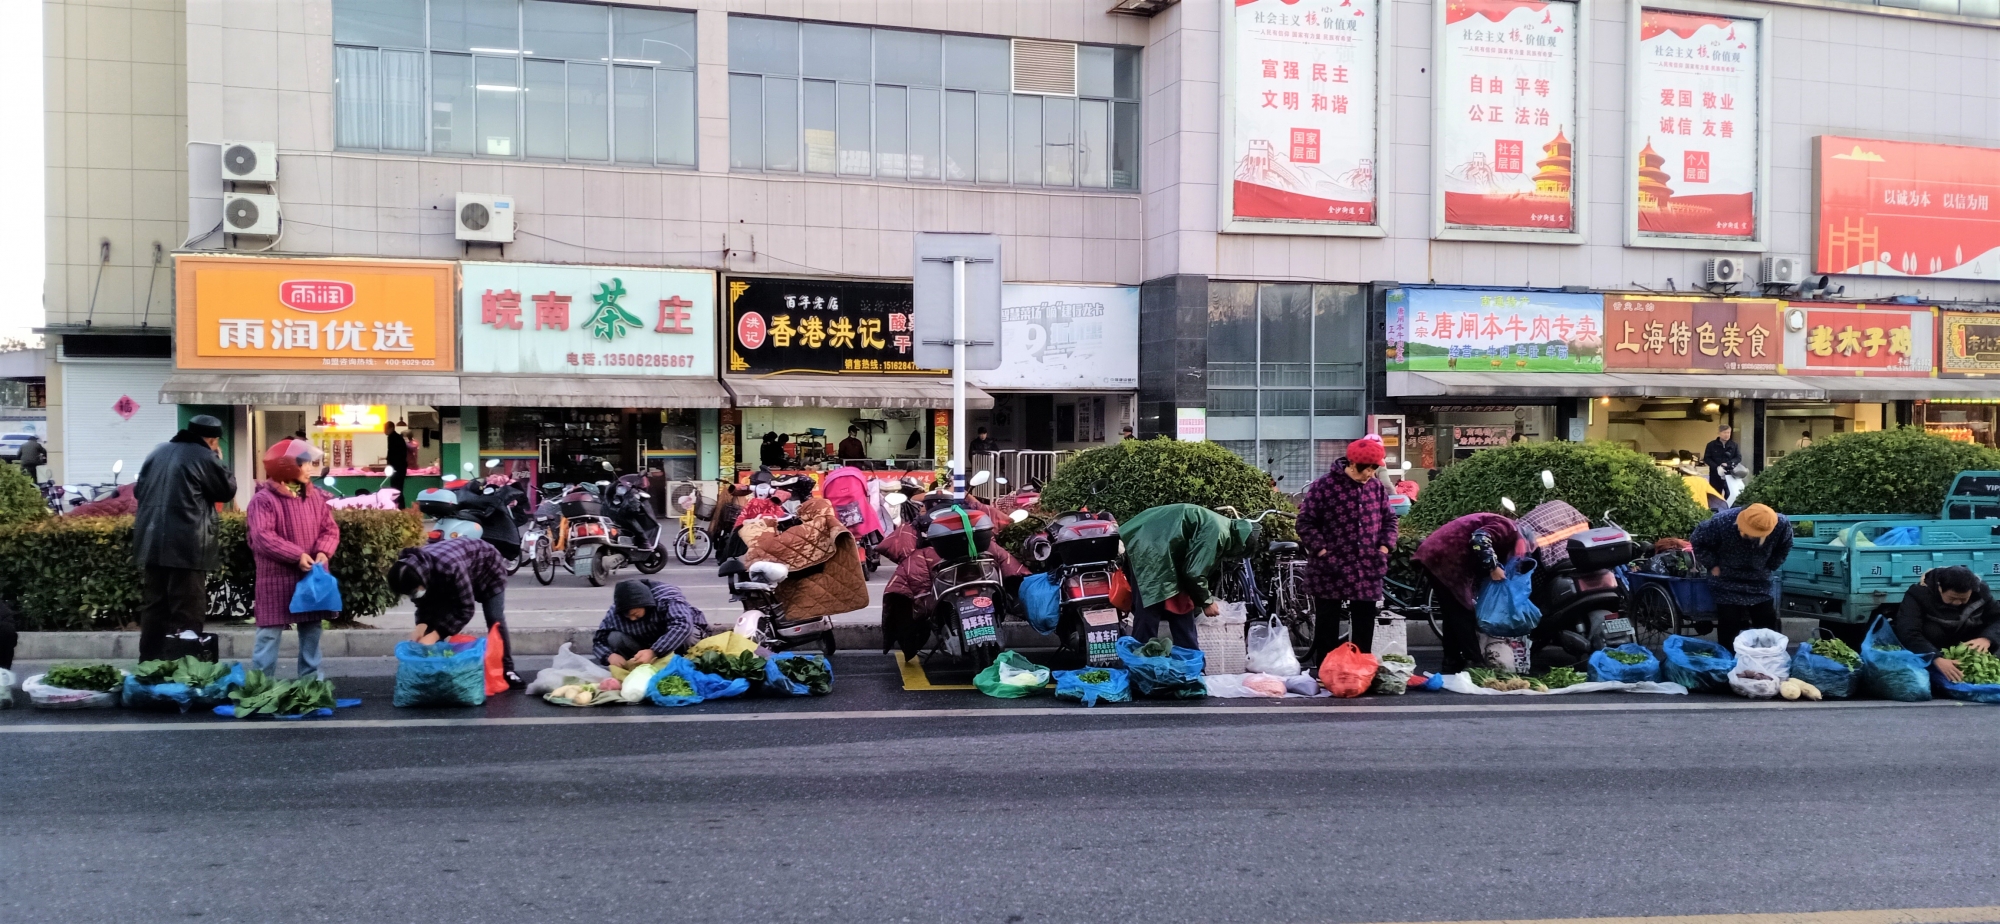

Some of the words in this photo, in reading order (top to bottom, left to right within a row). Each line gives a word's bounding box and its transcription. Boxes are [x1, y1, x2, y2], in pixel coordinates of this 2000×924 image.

[1260, 29, 1291, 38] 人民有信仰
[1292, 31, 1321, 40] 国家有力量
[1323, 32, 1352, 42] 民族有希望
[1469, 46, 1496, 54] 人民有信仰
[1498, 47, 1525, 56] 国家有力量
[1526, 49, 1553, 58] 民族有希望
[1262, 59, 1299, 80] 富强
[1312, 63, 1349, 83] 民主
[1470, 74, 1503, 94] 自由
[1515, 78, 1550, 97] 平等
[1262, 89, 1299, 110] 文明
[1311, 93, 1349, 114] 和谐
[1660, 89, 1692, 108] 爱国
[1702, 92, 1734, 110] 敬业
[1469, 104, 1503, 123] 公正
[1514, 107, 1550, 126] 法治
[1660, 116, 1692, 135] 诚信
[1702, 119, 1734, 139] 友善
[1293, 131, 1318, 145] 国家
[1293, 147, 1317, 160] 层面
[1497, 143, 1521, 156] 社会
[1497, 157, 1521, 171] 层面
[1686, 154, 1707, 166] 个人
[1686, 168, 1707, 180] 层面
[1884, 189, 1931, 207] 以诚为本
[1943, 193, 1989, 211] 以信为用
[291, 285, 344, 304] 雨润
[784, 295, 839, 310] 百年老店
[1480, 296, 1531, 307] 南通特产
[481, 277, 694, 342] 皖南茶庄
[218, 318, 415, 351] 雨润优选
[745, 317, 760, 343] 洪记
[768, 314, 885, 350] 香港洪记
[1415, 311, 1430, 338] 正宗
[1431, 311, 1598, 342] 唐闸本牛肉专卖
[893, 335, 912, 354] 干
[1615, 319, 1770, 358] 上海特色美食
[1807, 325, 1913, 357] 老木子鸡
[322, 357, 378, 367] 加盟咨询热线：
[1487, 345, 1509, 358] 牛肉
[1516, 346, 1539, 359] 牛肚
[1546, 346, 1568, 360] 牛筋
[1871, 565, 1882, 576] 动
[1912, 565, 1923, 575] 电
